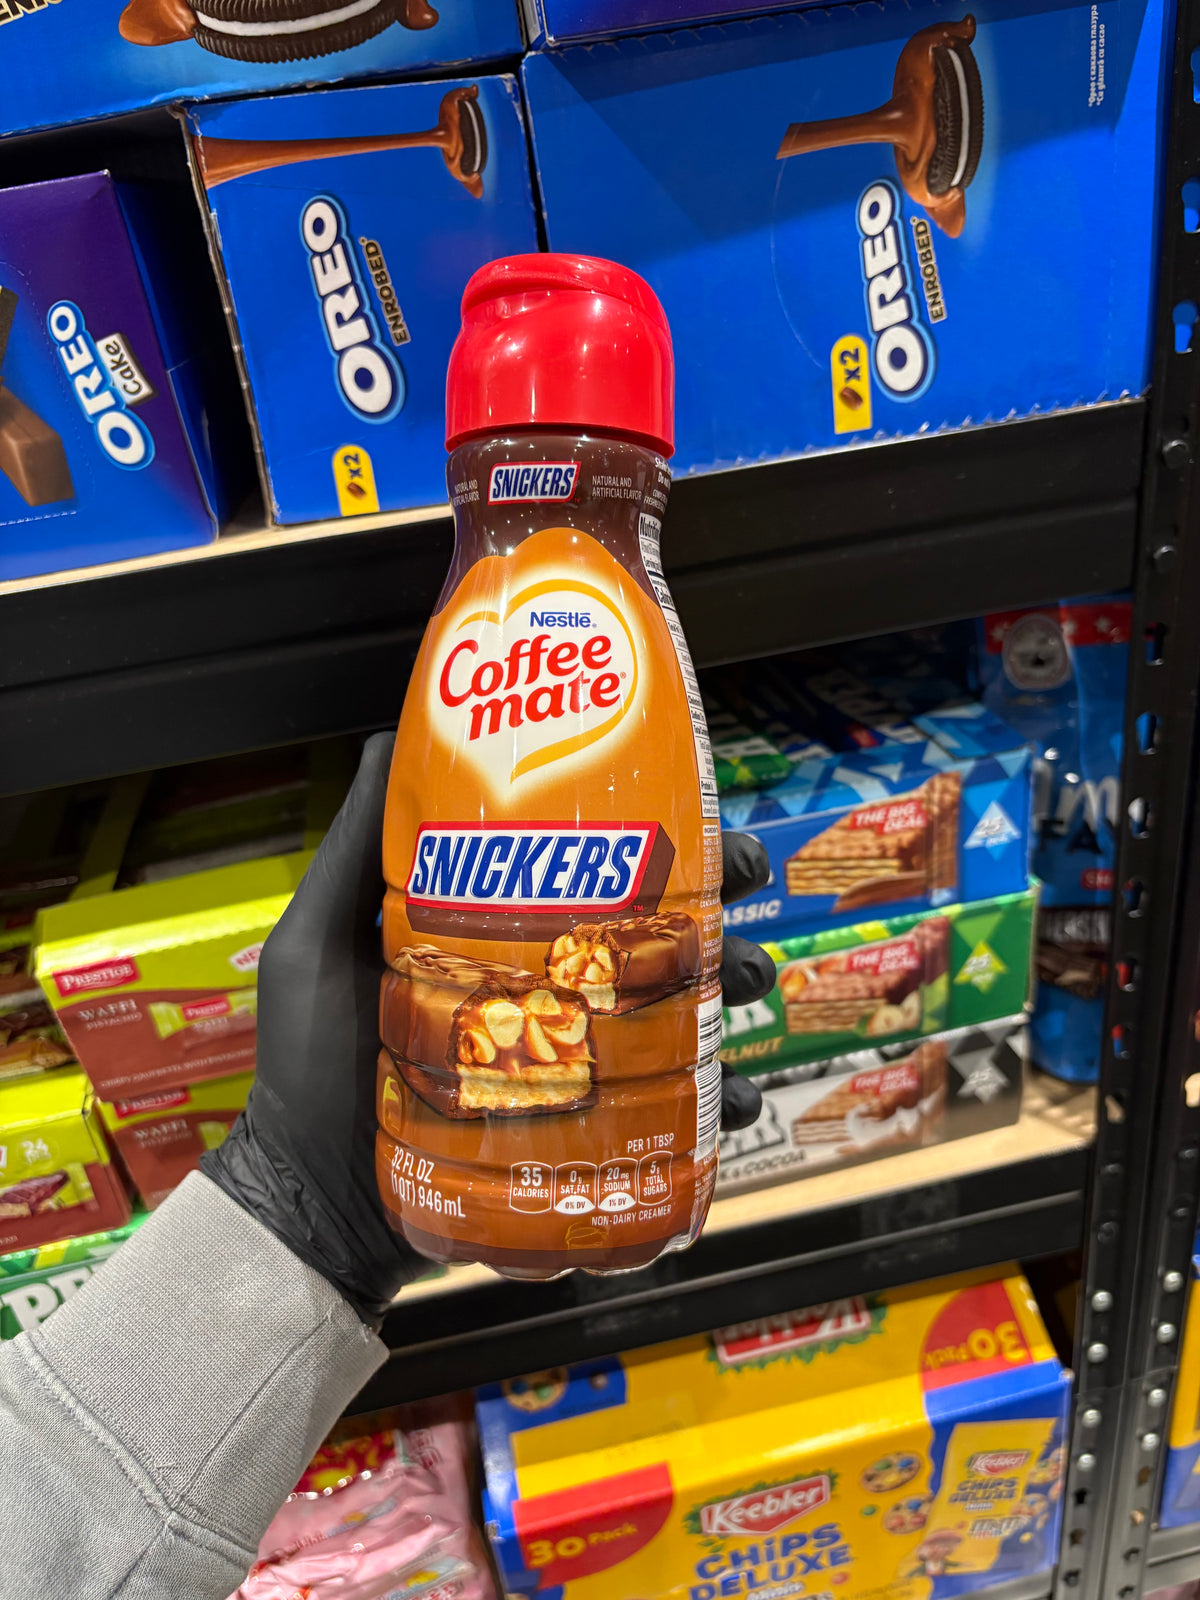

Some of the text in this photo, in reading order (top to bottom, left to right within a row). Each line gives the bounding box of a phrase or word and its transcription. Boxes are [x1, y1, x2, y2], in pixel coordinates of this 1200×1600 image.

[858, 183, 925, 393] OREO
[302, 200, 393, 414] OREO
[105, 339, 142, 396] Cake
[839, 347, 861, 384] x2
[50, 304, 146, 465] OREO
[343, 453, 363, 480] x2
[491, 463, 577, 499] SNICKERS
[591, 487, 622, 499] ARTIFICIAL
[623, 489, 642, 500] FLAVOR
[592, 475, 632, 488] NATURAL AND
[440, 634, 612, 708] Coffee
[469, 670, 621, 741] mate
[854, 801, 916, 828] THE BIG
[882, 813, 926, 833] DEAL
[412, 835, 643, 899] SNICKERS
[721, 898, 782, 927] ASSIC
[850, 941, 909, 969] THE BIG
[878, 956, 919, 974] DEAL
[62, 964, 134, 989] PRESTIGE
[721, 1035, 785, 1064] ELNUT
[853, 1071, 880, 1090] THE
[878, 1076, 917, 1093] DEAL
[627, 1132, 675, 1153] PER 1 TBSP
[391, 1145, 435, 1183] 32 FL OZ
[520, 1166, 543, 1187] 35
[512, 1188, 550, 1199] CALORIES
[576, 1183, 590, 1194] FAT
[603, 1180, 631, 1192] SODIUM
[643, 1182, 668, 1197] SUGARS
[645, 1174, 664, 1186] TOTAL
[418, 1185, 442, 1213] 946
[444, 1195, 467, 1218] mL
[575, 1201, 586, 1209] DV
[591, 1204, 672, 1226] NON-DAIRY CREAMER
[617, 1197, 627, 1206] DV
[966, 1320, 1026, 1362] 30
[706, 1484, 823, 1534] Keebler
[527, 1536, 587, 1568] 30
[689, 1543, 852, 1600] DELUXE
